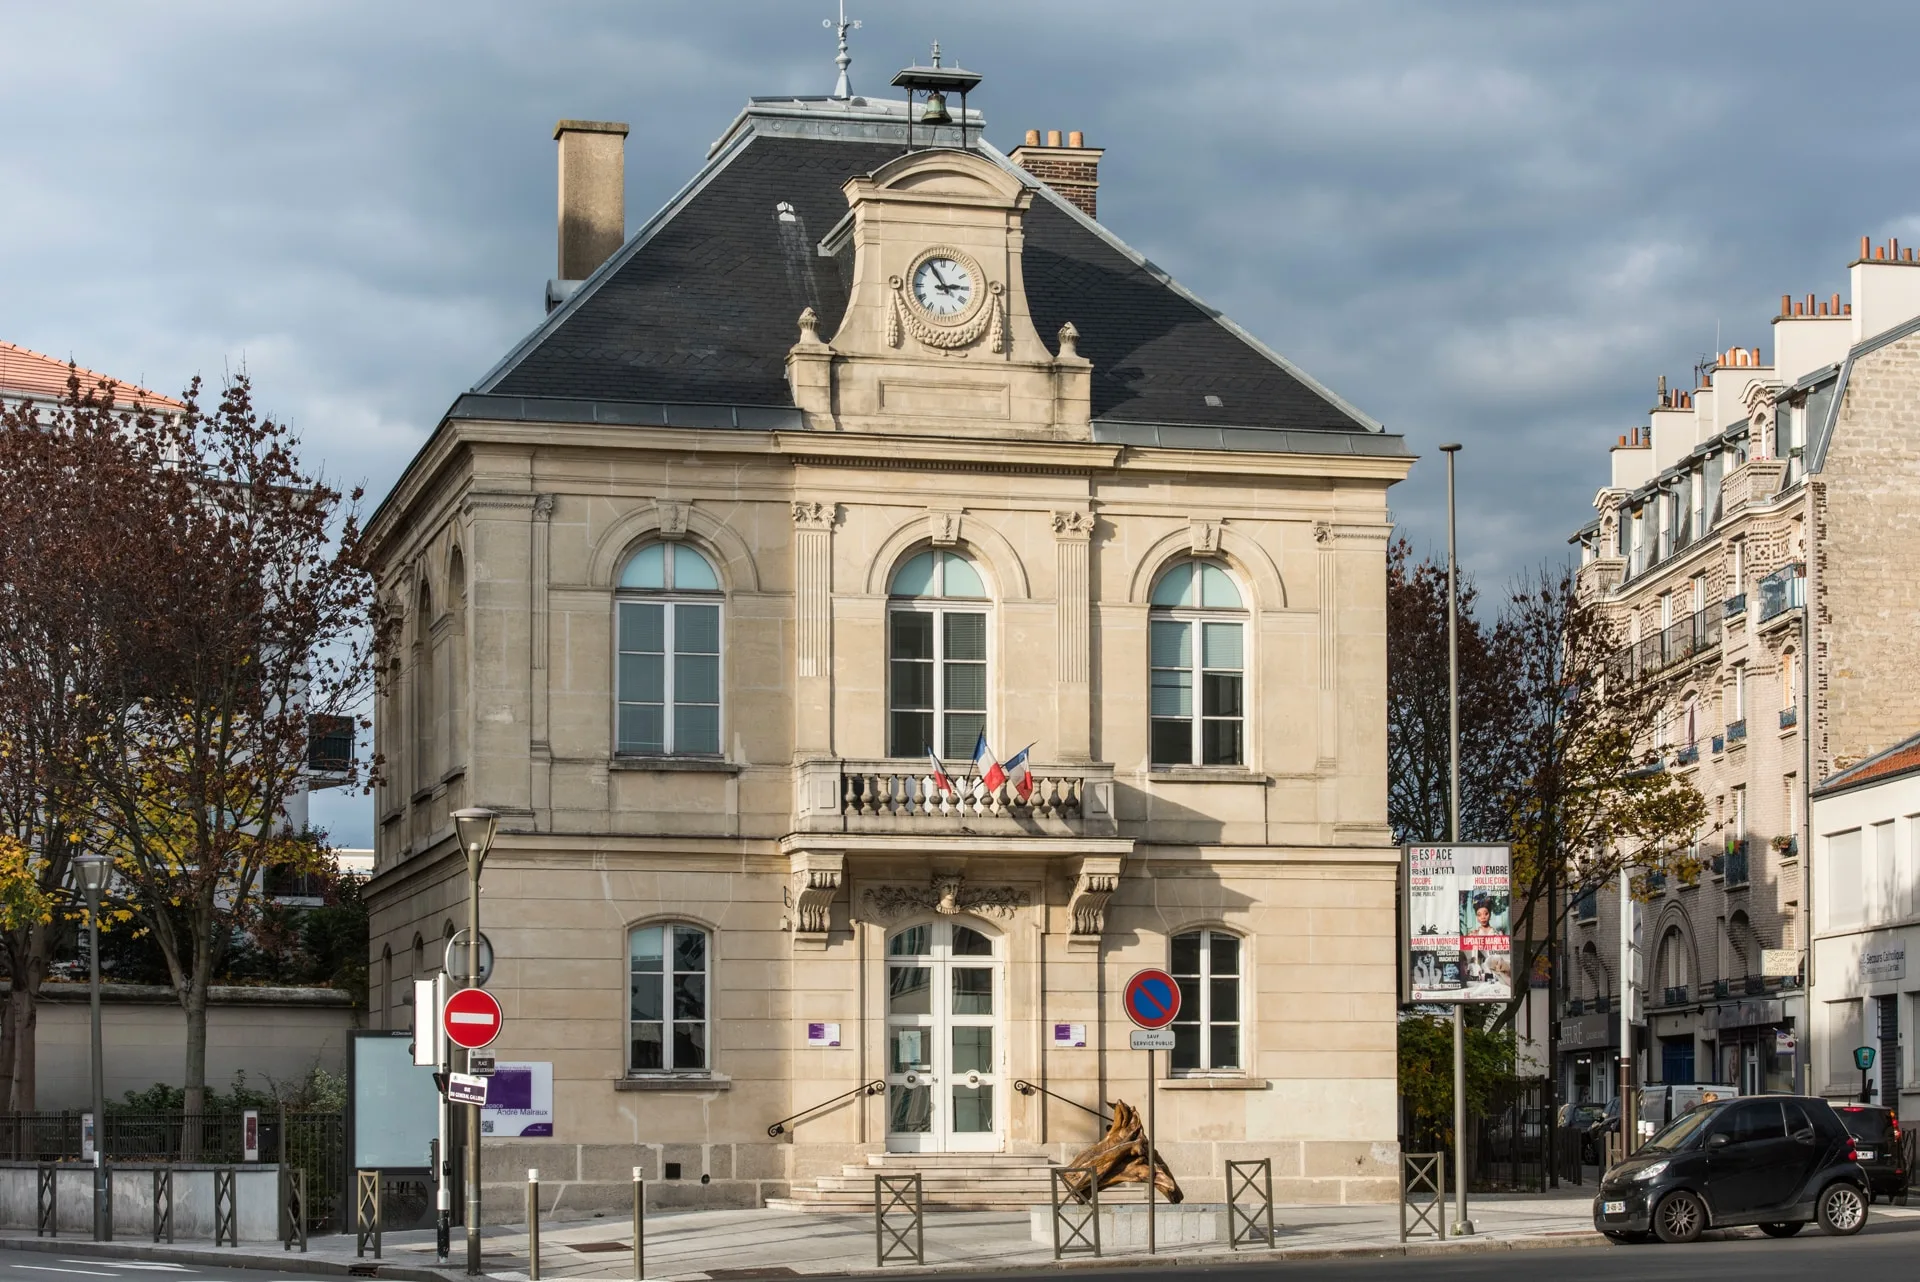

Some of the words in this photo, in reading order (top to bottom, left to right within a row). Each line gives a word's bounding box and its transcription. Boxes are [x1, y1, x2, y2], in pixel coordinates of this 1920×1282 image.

[1419, 848, 1452, 860] ESPACE
[1472, 865, 1509, 875] NOVEMBRE
[1474, 877, 1493, 885] HOLLIE
[1493, 877, 1509, 885] COOK
[1436, 937, 1459, 945] MONROE
[1463, 937, 1485, 945] UPDATE
[1866, 953, 1882, 964] Secours
[497, 1107, 518, 1116] André
[519, 1107, 548, 1116] Malraux
